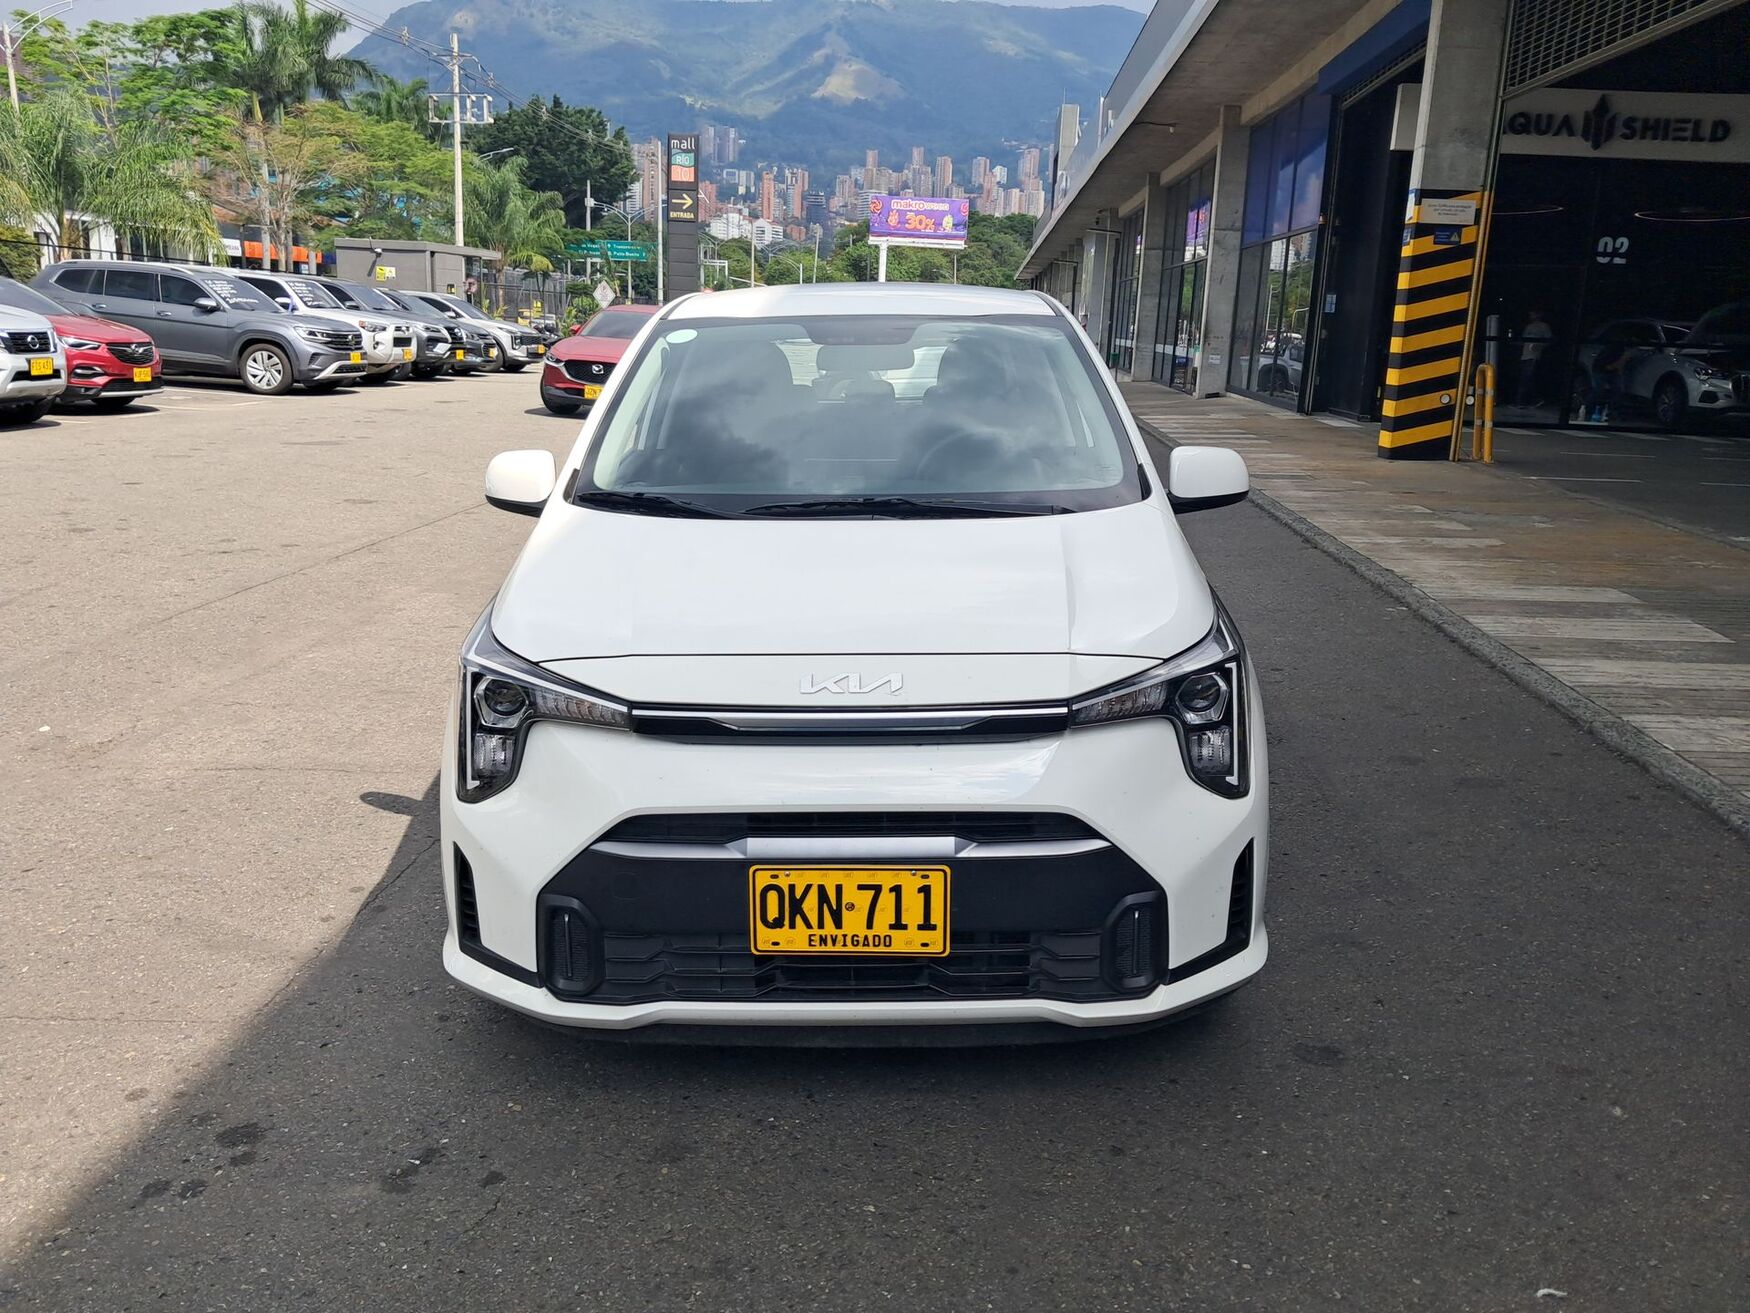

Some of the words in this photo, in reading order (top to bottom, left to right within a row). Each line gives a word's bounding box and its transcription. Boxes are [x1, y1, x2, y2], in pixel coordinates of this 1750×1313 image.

[1503, 111, 1575, 137] QUA
[1620, 116, 1732, 143] SHIELD
[671, 137, 695, 149] mall
[905, 214, 935, 231] 30%
[1596, 236, 1630, 265] 02
[800, 672, 903, 694] KIA
[759, 883, 843, 930] QKN
[857, 883, 938, 931] 711
[808, 933, 893, 947] ENVIGADO
